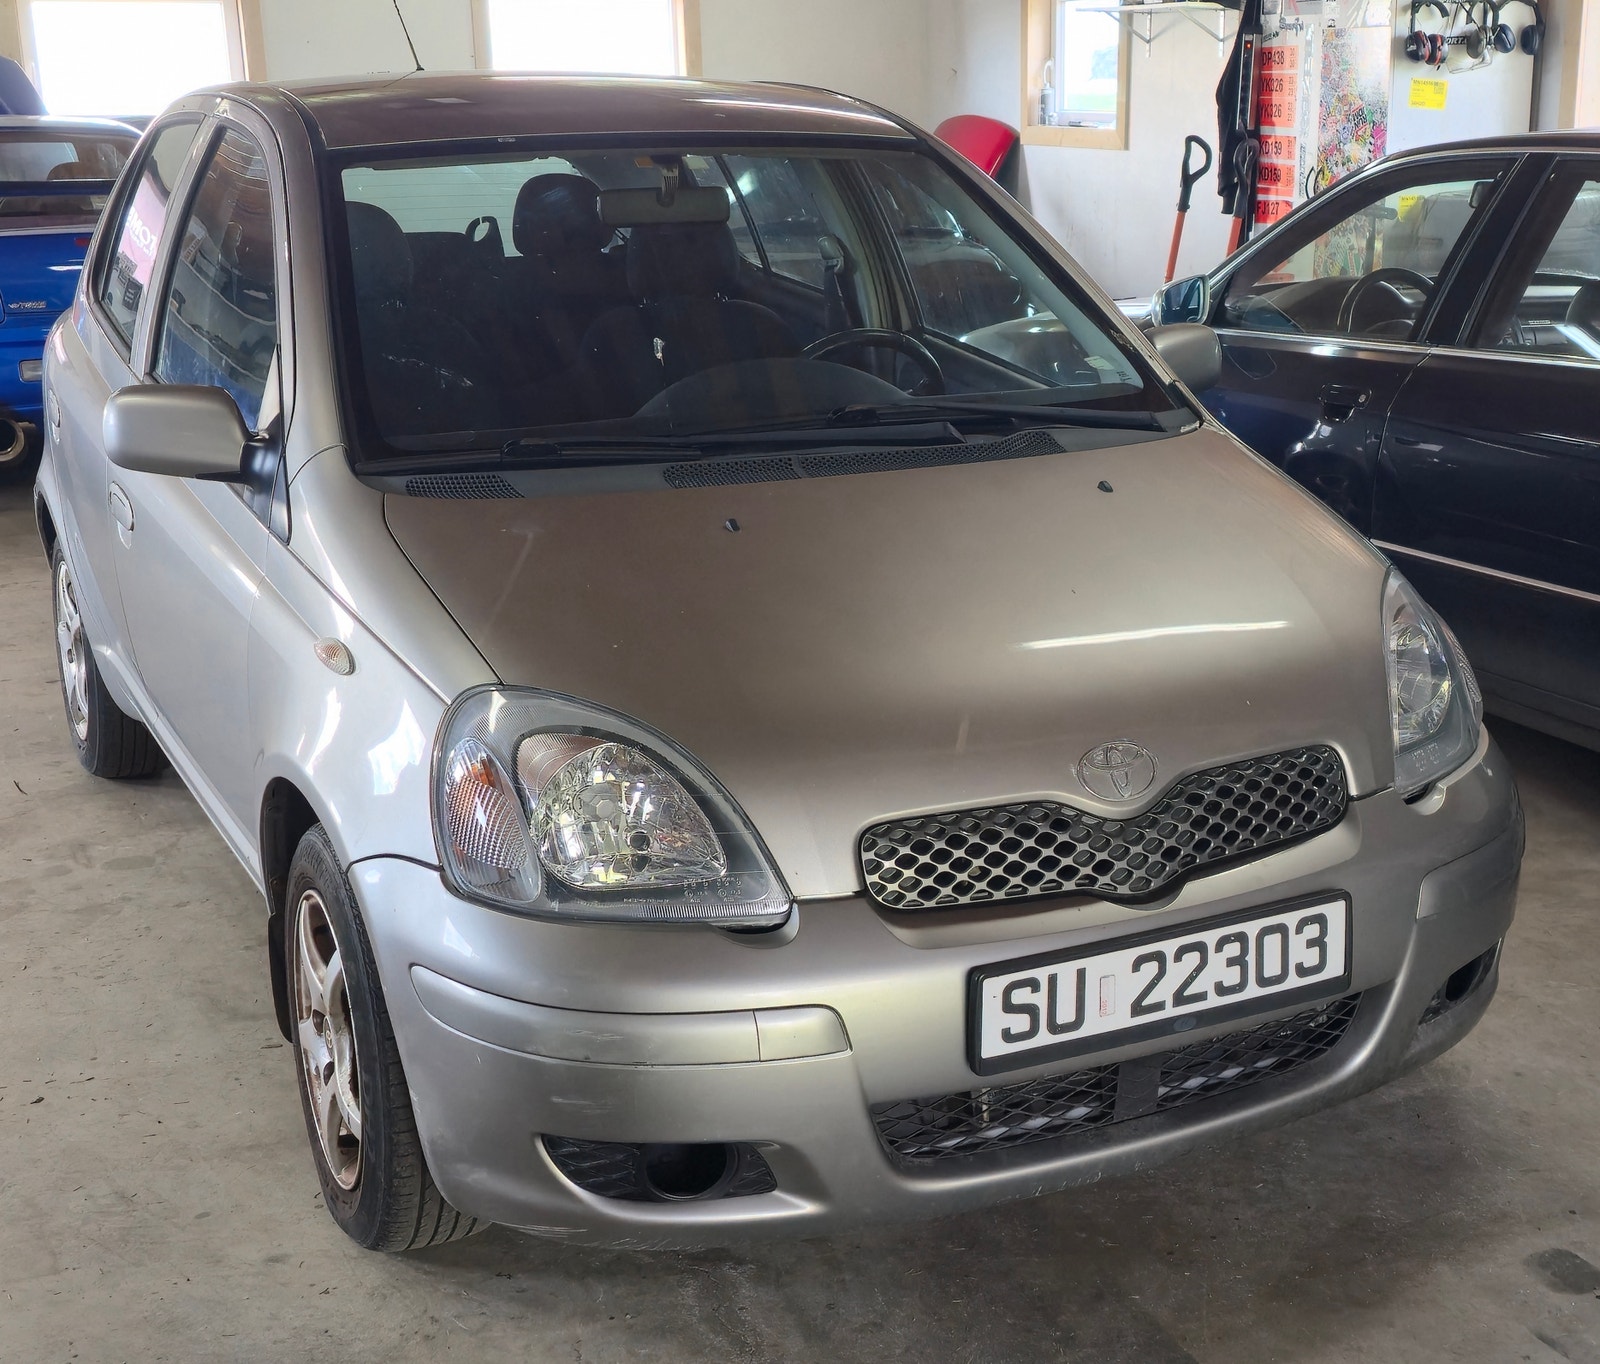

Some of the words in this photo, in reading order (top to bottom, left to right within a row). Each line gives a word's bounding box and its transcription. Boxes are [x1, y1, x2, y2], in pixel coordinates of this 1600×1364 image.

[1262, 50, 1285, 66] DP438
[1260, 140, 1283, 156] KD159
[1258, 166, 1281, 182] KD159
[1256, 201, 1280, 216] FJ127
[1001, 967, 1086, 1043] SU
[1130, 913, 1329, 1018] 22303
